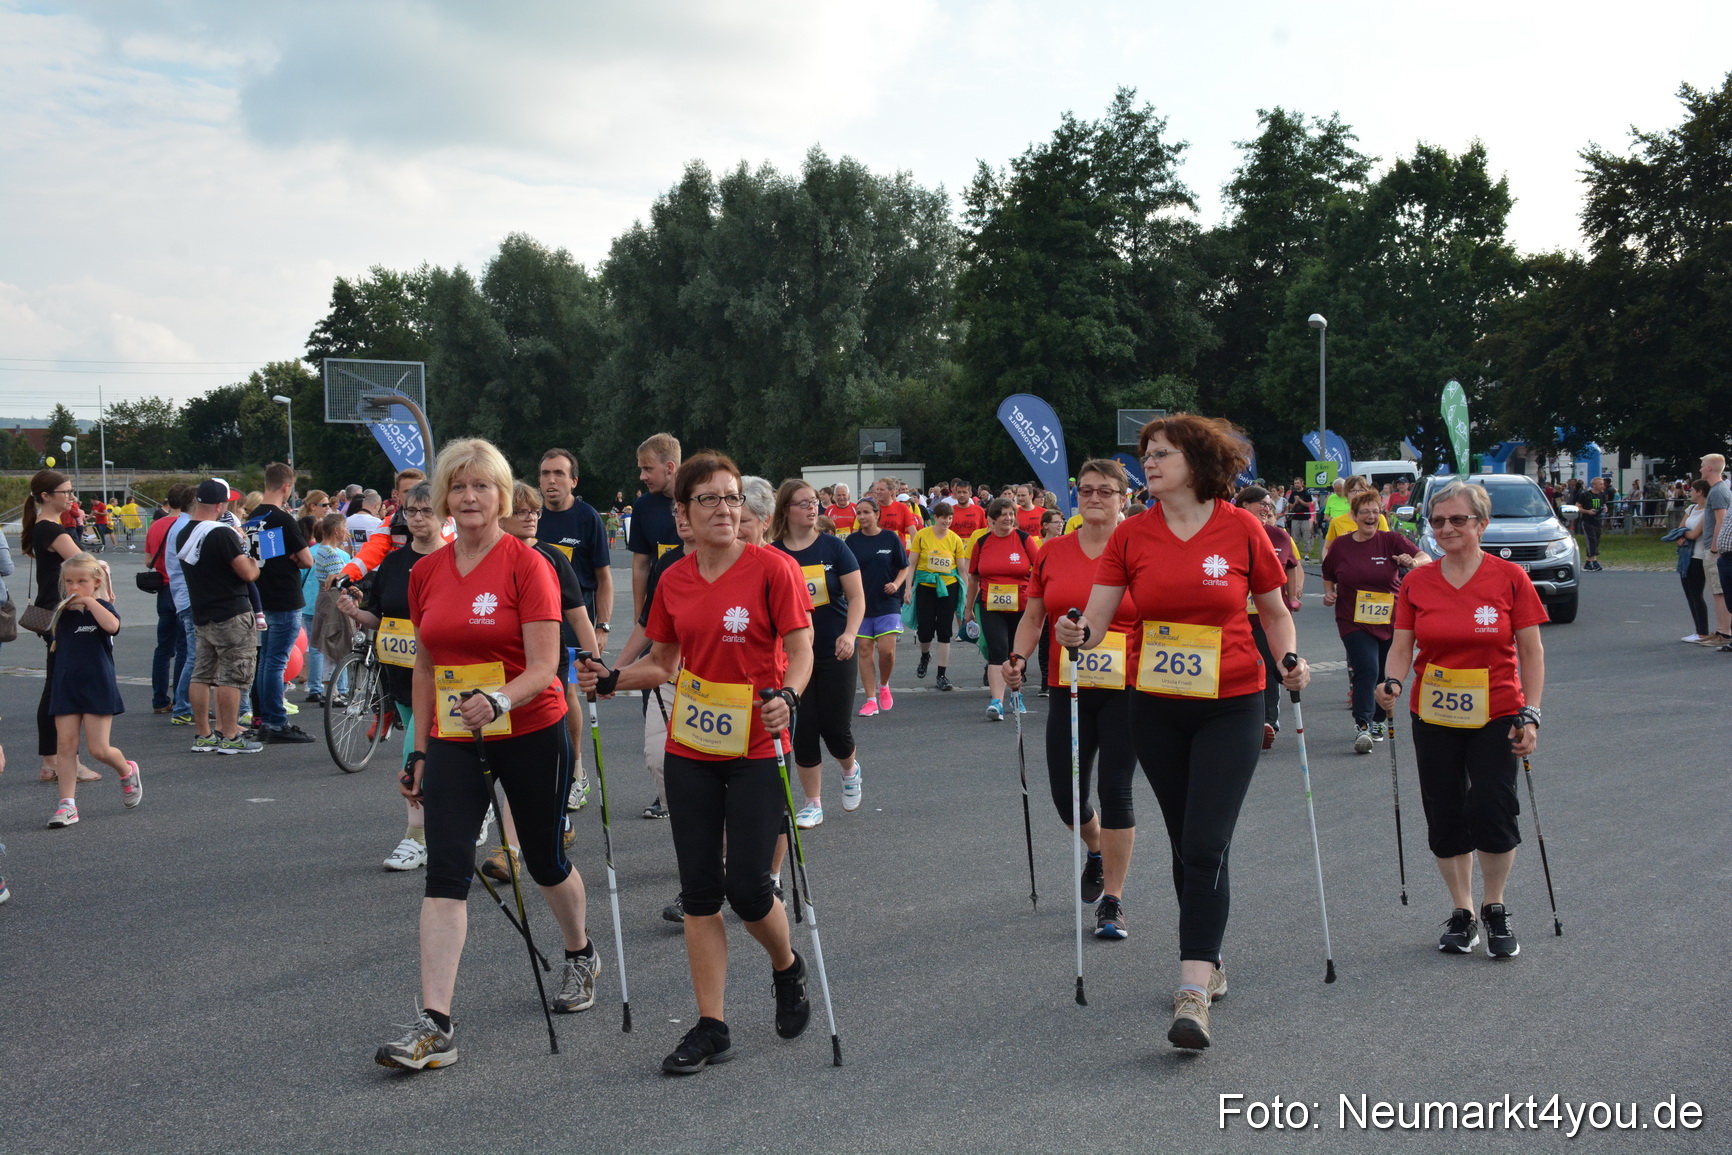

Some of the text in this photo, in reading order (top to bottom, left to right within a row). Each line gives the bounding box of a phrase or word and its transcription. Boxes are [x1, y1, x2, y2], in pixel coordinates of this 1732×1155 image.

[930, 557, 950, 567] 1265
[1202, 579, 1229, 587] caritas
[993, 595, 1012, 604] 268
[1360, 604, 1390, 616] 1125
[468, 617, 496, 625] caritas
[722, 634, 746, 643] caritas
[381, 636, 418, 656] 1203
[1077, 652, 1112, 673] 262
[1153, 650, 1202, 677] 263
[1432, 690, 1474, 712] 258
[685, 704, 733, 736] 266
